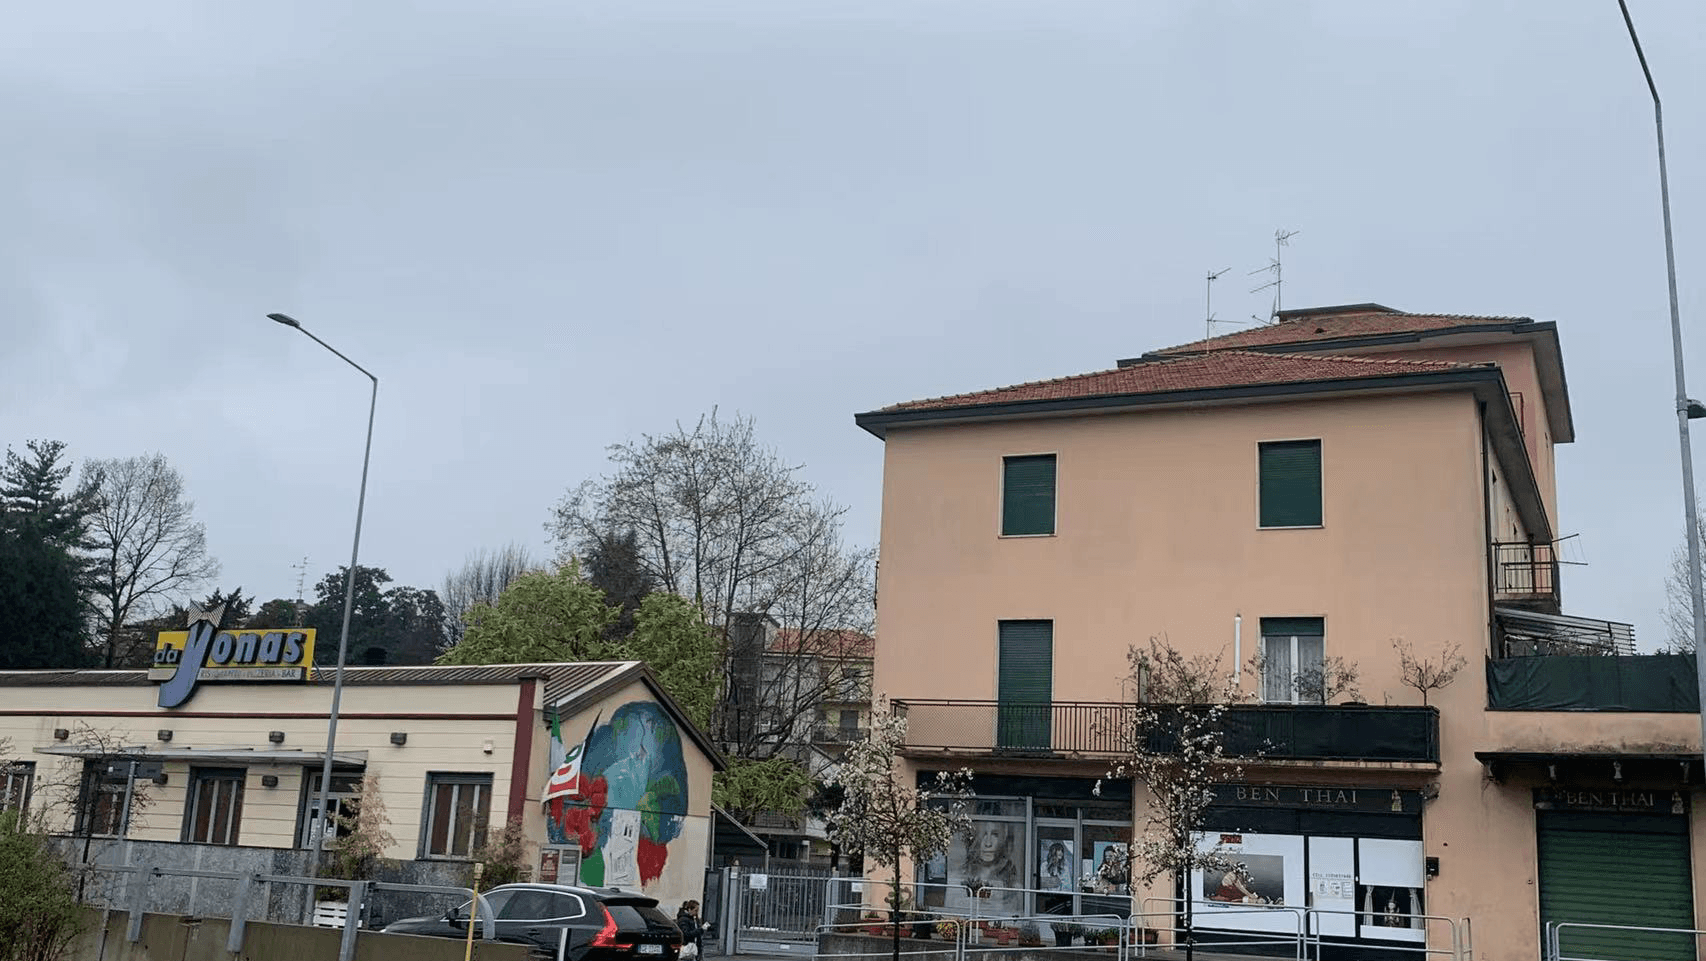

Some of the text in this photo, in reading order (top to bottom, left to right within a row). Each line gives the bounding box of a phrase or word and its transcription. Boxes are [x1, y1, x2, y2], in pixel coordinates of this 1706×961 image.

[154, 643, 182, 664] da
[281, 669, 296, 678] BAR
[1236, 786, 1357, 803] BEN THAI
[1567, 791, 1654, 807] BEN THAI
